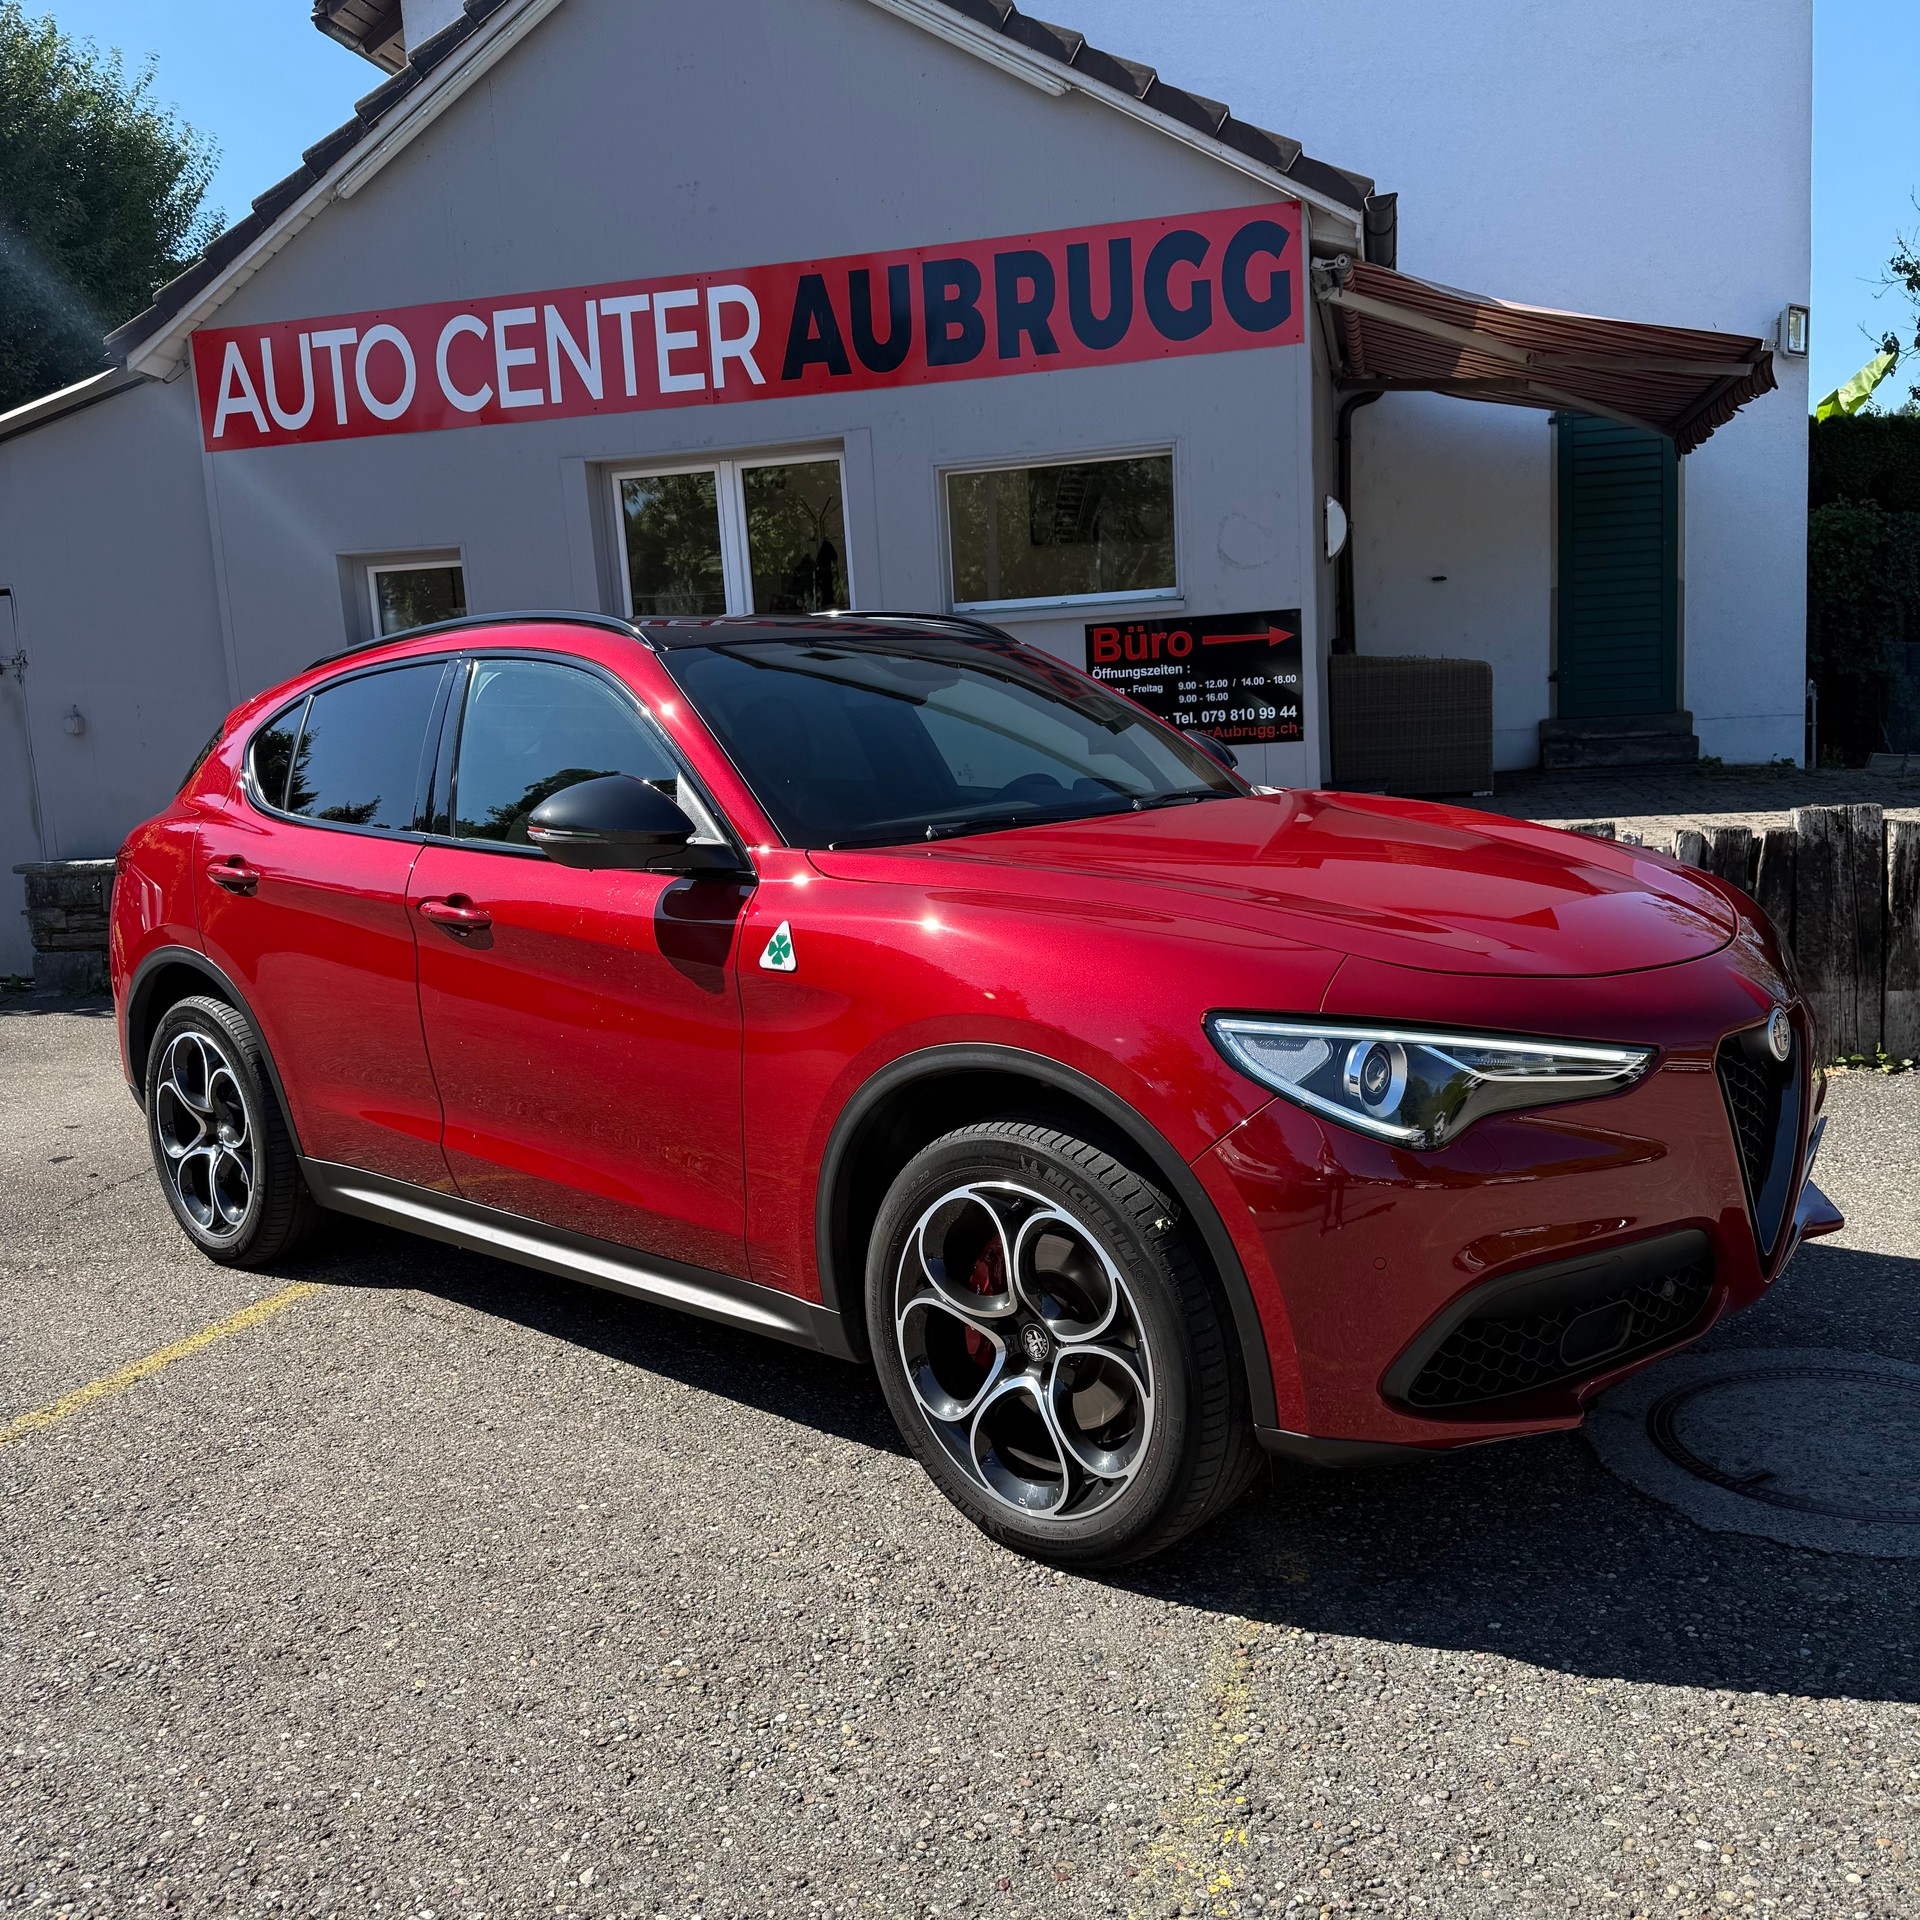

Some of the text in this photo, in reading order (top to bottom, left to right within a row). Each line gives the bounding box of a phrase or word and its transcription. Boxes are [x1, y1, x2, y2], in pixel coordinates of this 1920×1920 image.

[212, 220, 1291, 438] AUTO CENTER AUBRUGG
[1093, 625, 1193, 663] Büro
[1092, 664, 1183, 680] Öffnungszeiten
[1133, 684, 1163, 694] Freitag
[1178, 681, 1197, 690] 9.00
[1205, 679, 1228, 689] 12.00
[1241, 676, 1265, 686] 14.00
[1273, 674, 1297, 684] 18.00
[1178, 694, 1197, 704] 9.00
[1205, 692, 1229, 702] 16.00
[1173, 711, 1198, 725] Tel.
[1201, 709, 1226, 723] 079
[1230, 708, 1255, 721] 810
[1259, 706, 1276, 719] 99
[1280, 705, 1298, 718] 44
[1042, 1165, 1138, 1264] MICHELIN
